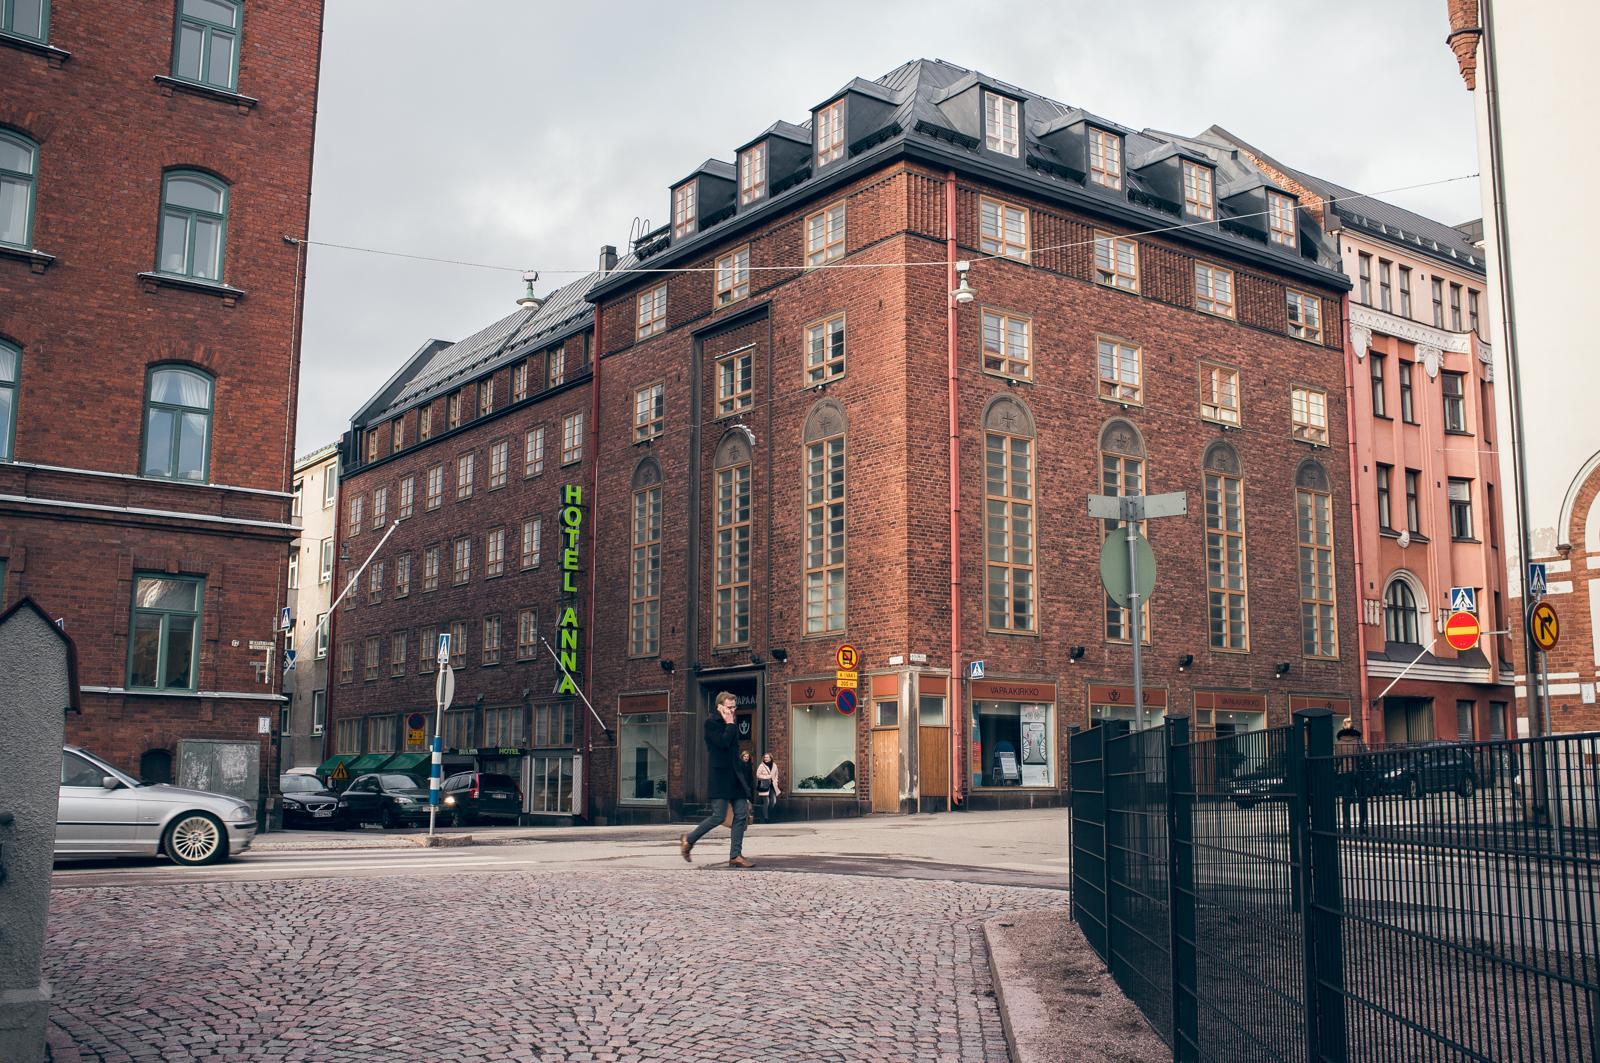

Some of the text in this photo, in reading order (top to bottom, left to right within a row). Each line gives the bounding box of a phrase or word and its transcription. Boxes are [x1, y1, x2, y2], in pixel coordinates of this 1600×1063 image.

[558, 484, 582, 695] HOTEL ANNA
[990, 686, 1040, 696] VAPAAKIRKKO
